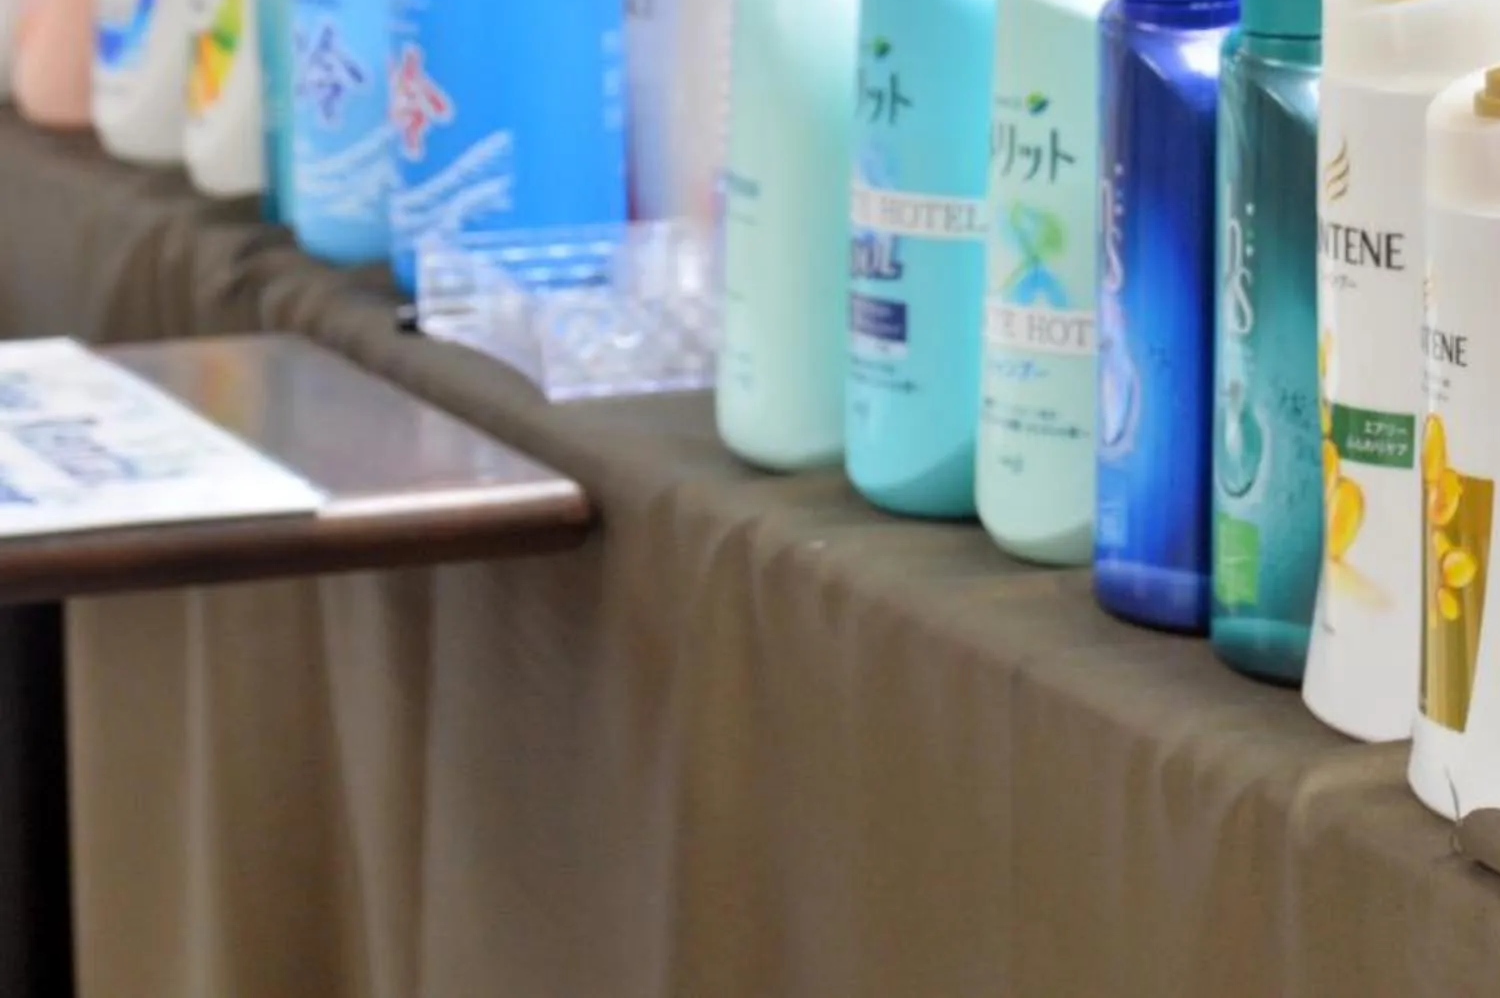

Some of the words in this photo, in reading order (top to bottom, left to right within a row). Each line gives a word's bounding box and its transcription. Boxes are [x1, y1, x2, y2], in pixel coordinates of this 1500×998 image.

[989, 118, 1076, 185] リット
[1026, 313, 1095, 349] HOT
